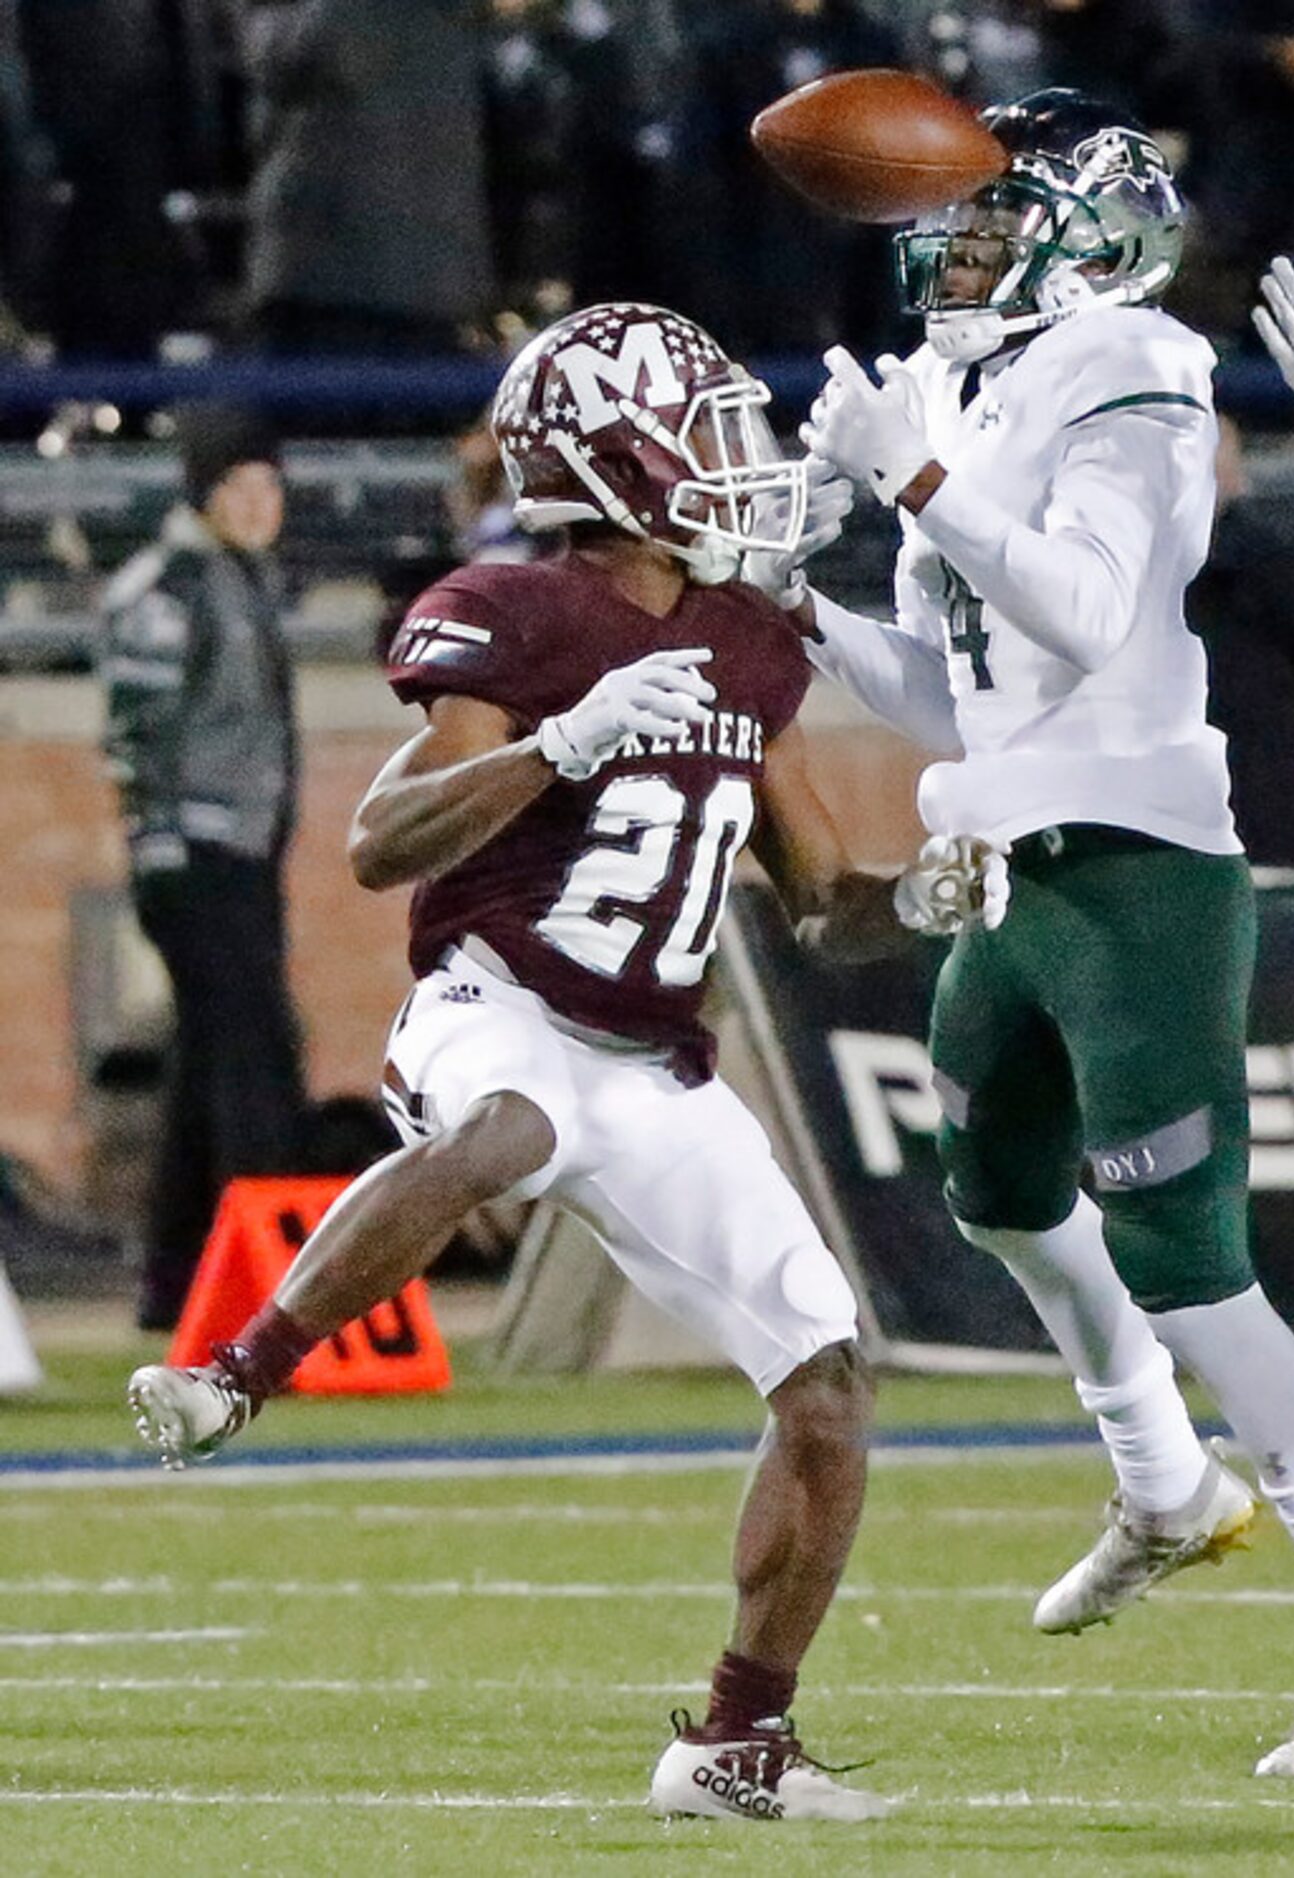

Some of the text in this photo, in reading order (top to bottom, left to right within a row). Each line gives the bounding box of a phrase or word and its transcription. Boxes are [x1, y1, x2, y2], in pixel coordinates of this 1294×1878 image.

[552, 322, 687, 436] M
[622, 710, 764, 764] KETERS
[531, 772, 755, 988] 20
[692, 1766, 787, 1820] adidas
